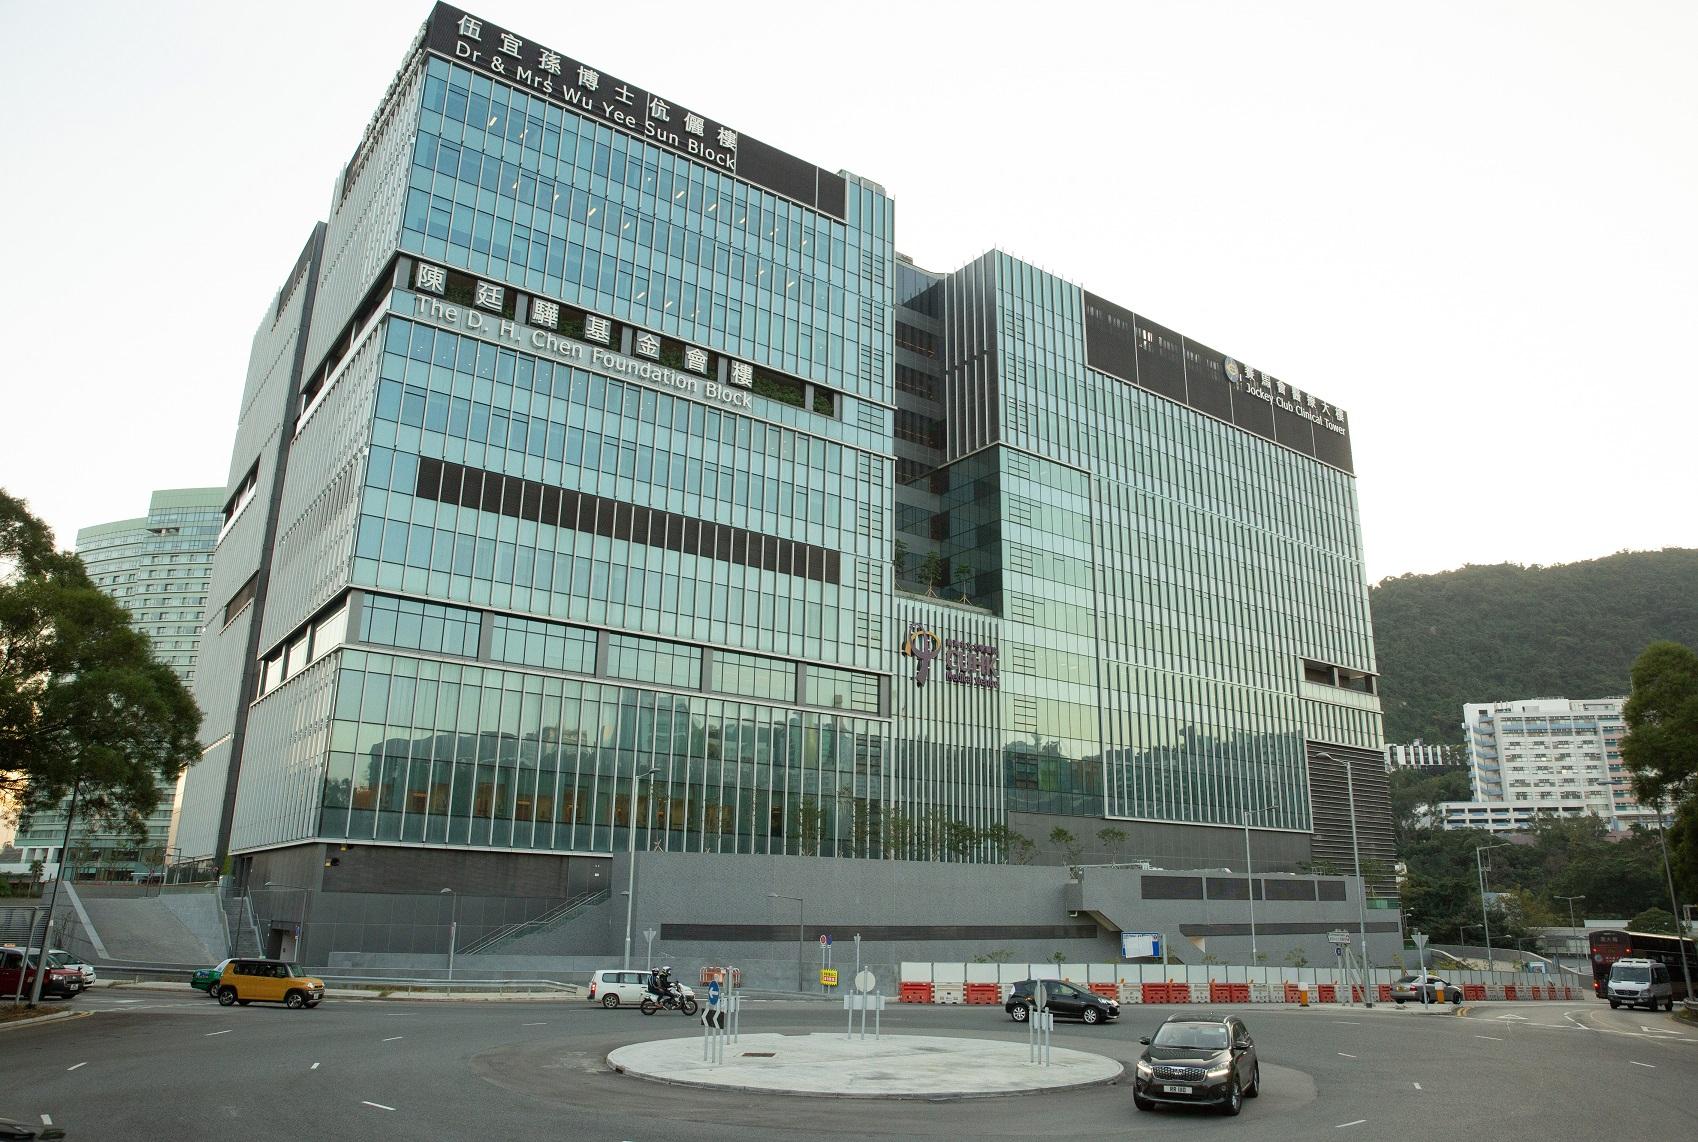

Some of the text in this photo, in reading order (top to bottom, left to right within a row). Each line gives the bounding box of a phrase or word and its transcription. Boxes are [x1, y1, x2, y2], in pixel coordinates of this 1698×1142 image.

[455, 40, 736, 170] Dr & Mrs Wu Yee Sun Block
[456, 14, 737, 150] 伍宜孫博士伉儷樓
[415, 294, 753, 408] The D. H. Chen Foundation Block
[417, 262, 753, 388] 陳廷驊基金會樓
[1246, 383, 1346, 436] Jockey Club Clinical Tower
[946, 649, 999, 678] CUHK
